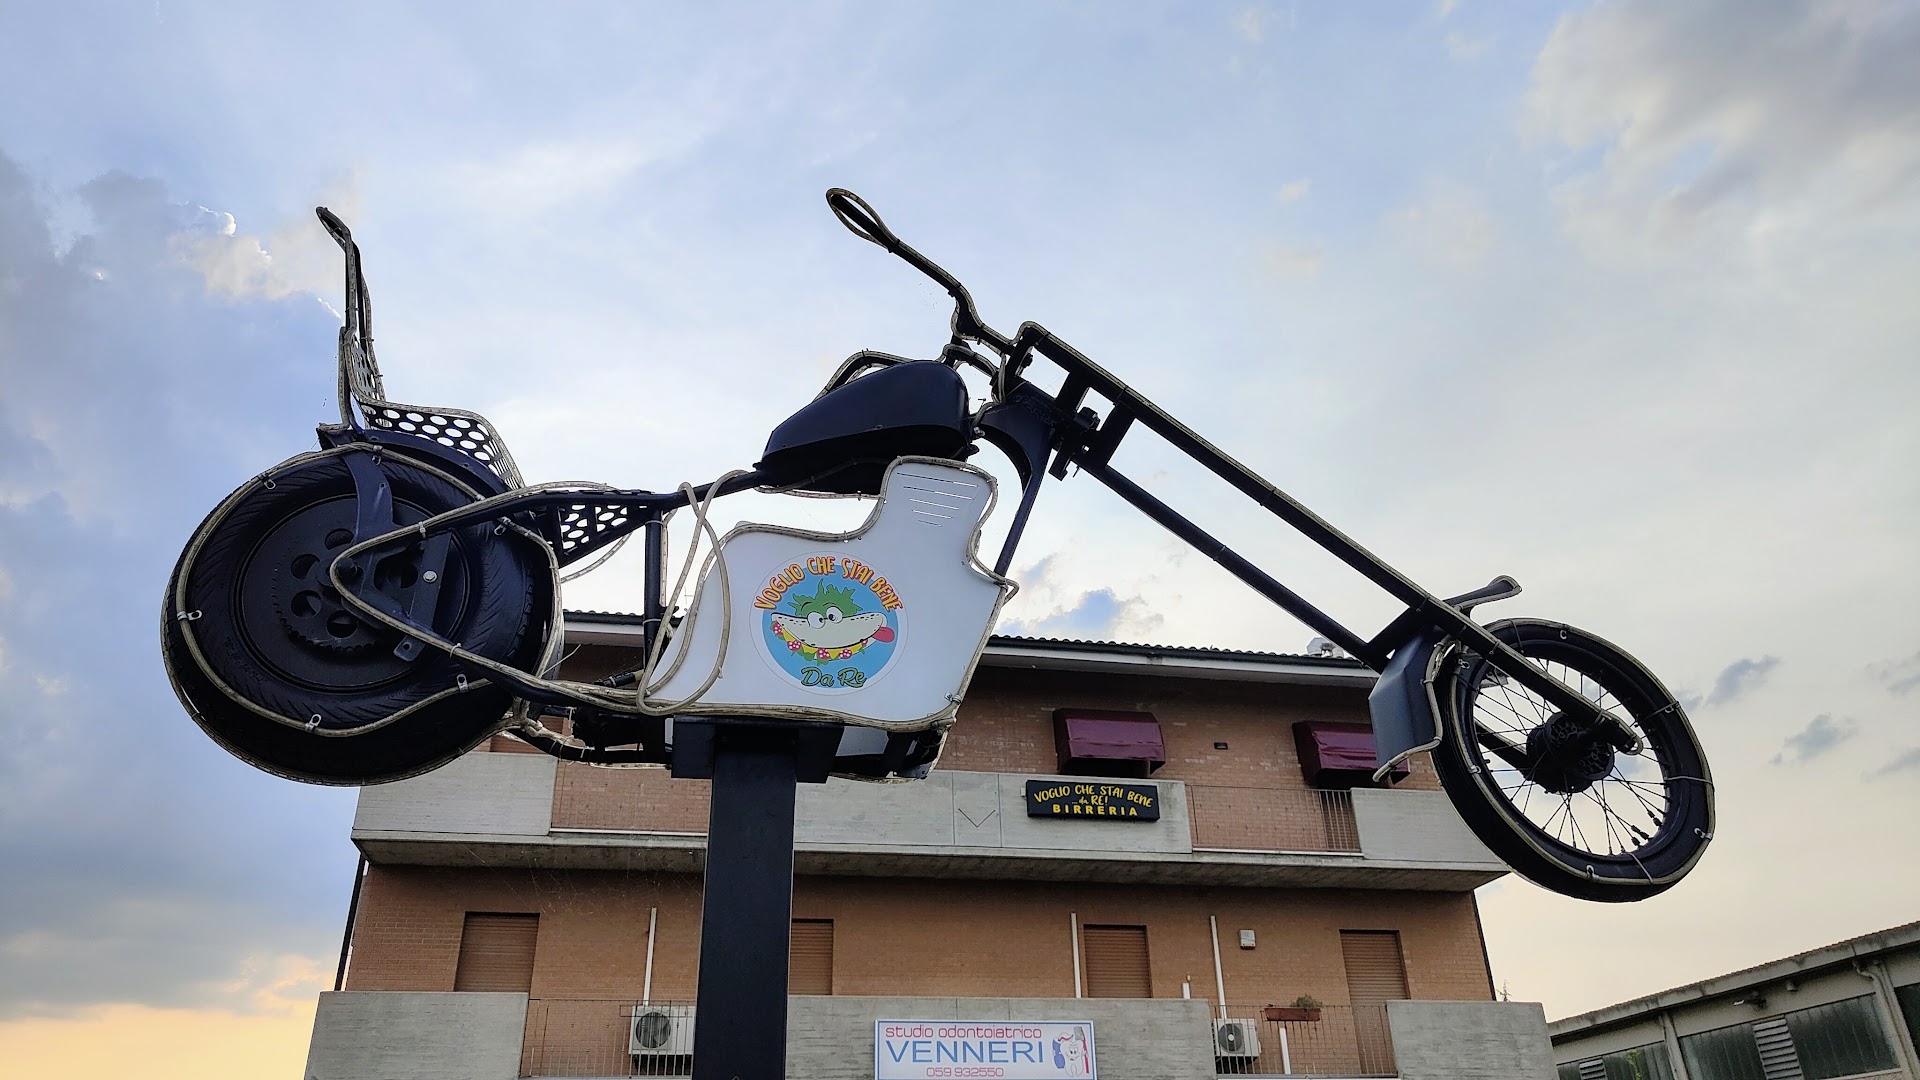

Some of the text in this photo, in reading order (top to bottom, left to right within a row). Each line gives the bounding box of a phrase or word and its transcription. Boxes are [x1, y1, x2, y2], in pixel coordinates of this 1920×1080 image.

[754, 556, 903, 612] VOGLIO CHE STAI BENE
[801, 666, 867, 688] Da Re
[1034, 785, 1153, 807] VOGLIO CHE STAI BENE
[1091, 795, 1108, 806] RE!
[1052, 804, 1137, 816] BIRRERIA
[885, 1024, 1042, 1038] studio odontoiatrico
[886, 1040, 1043, 1063] VENNERI
[926, 1067, 1004, 1077] 059 932550
